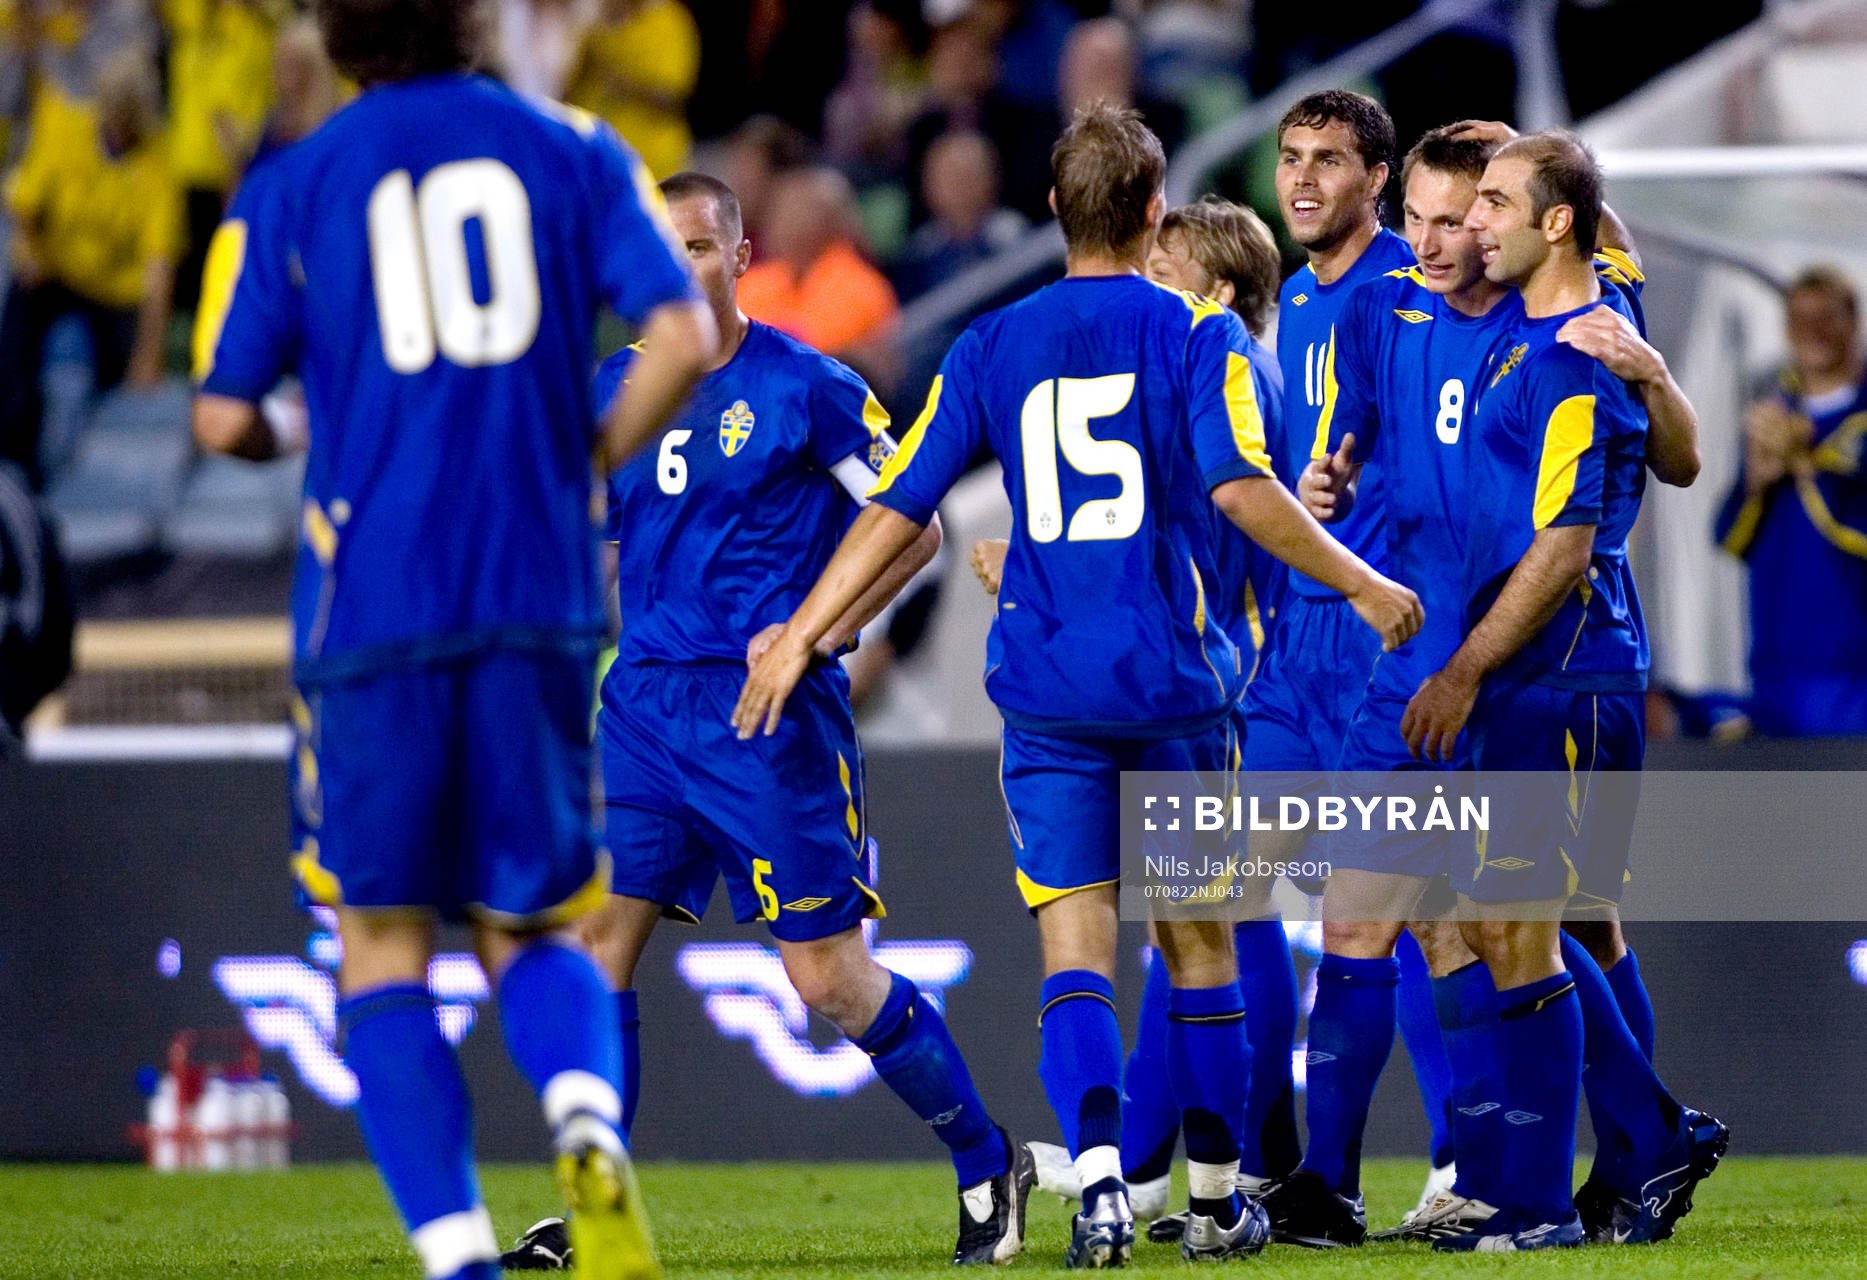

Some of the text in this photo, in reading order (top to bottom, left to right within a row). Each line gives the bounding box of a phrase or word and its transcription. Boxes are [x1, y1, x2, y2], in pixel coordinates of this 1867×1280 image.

[366, 157, 542, 375] 10
[657, 429, 693, 495] 6
[1020, 372, 1145, 543] 15
[1435, 378, 1465, 445] 8
